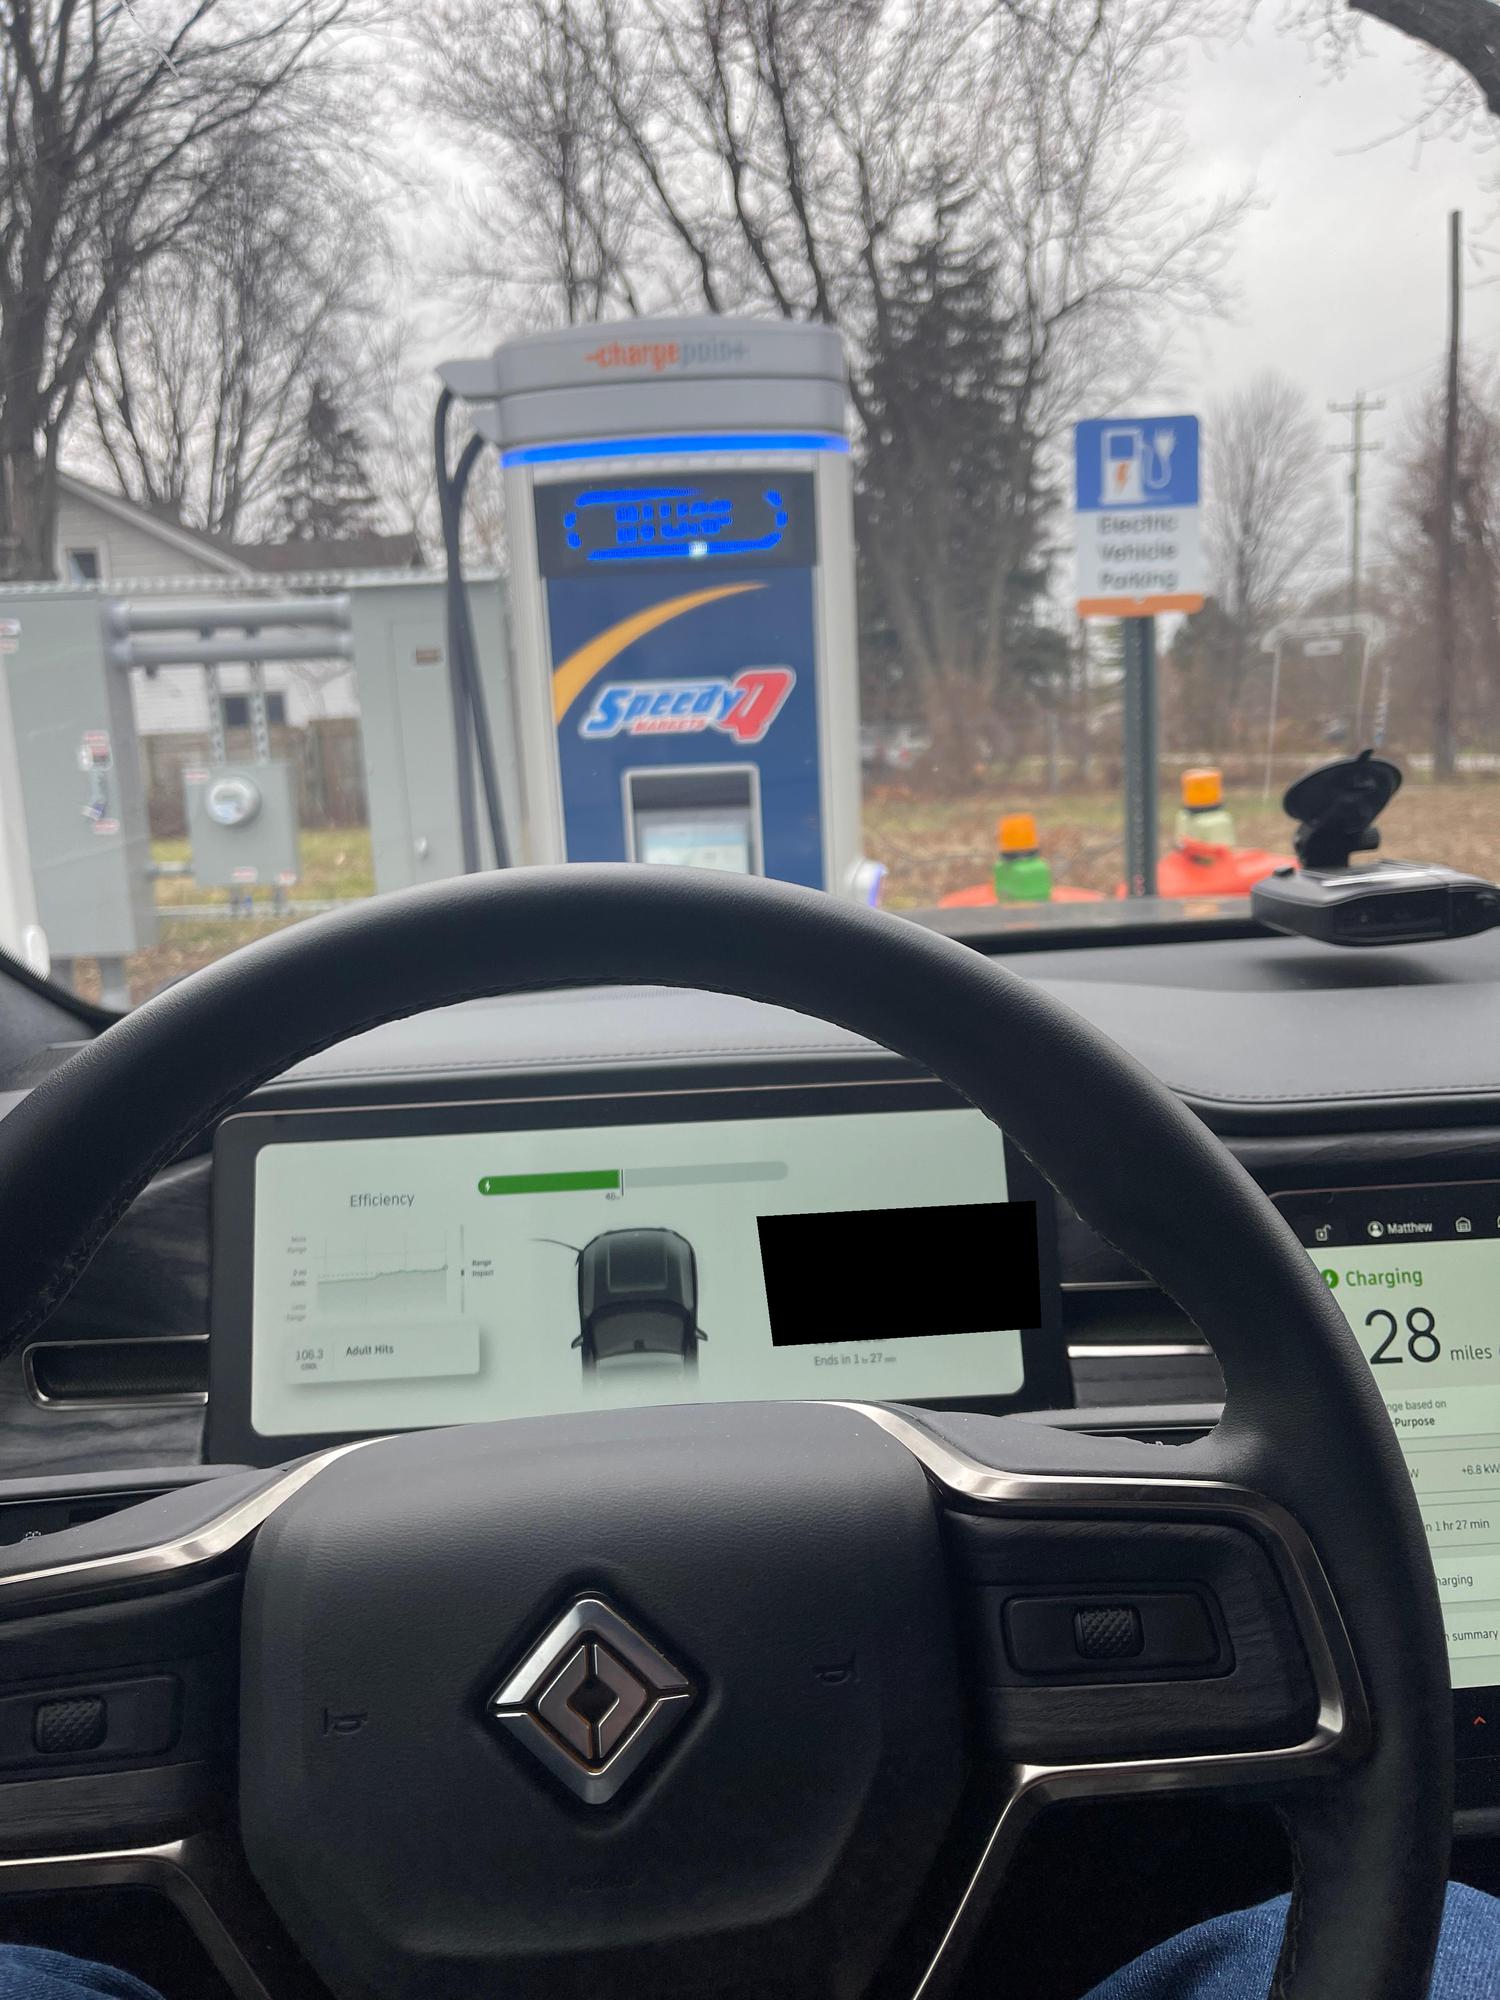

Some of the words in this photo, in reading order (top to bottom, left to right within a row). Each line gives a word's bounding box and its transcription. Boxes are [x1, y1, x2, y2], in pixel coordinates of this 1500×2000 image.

[1099, 516, 1178, 534] Electric
[1101, 544, 1177, 561] Vehicle
[1101, 572, 1178, 589] Parking
[350, 1192, 415, 1208] Efficiency
[1387, 1222, 1433, 1235] Matthew
[1346, 1268, 1423, 1289] Charging
[1365, 1307, 1441, 1365] 28
[1450, 1345, 1493, 1361] miles
[346, 1346, 372, 1356] Adult
[375, 1345, 394, 1355] Hits
[814, 1354, 839, 1366] Ends
[842, 1354, 851, 1365] in
[854, 1354, 860, 1364] 1
[870, 1353, 883, 1363] 27
[1386, 1402, 1403, 1413] nge
[1405, 1400, 1433, 1410] based
[1435, 1400, 1447, 1409] on
[1436, 1521, 1441, 1531] 1
[1443, 1520, 1454, 1531] hr
[1456, 1519, 1468, 1530] 27
[1469, 1518, 1490, 1529] min
[1452, 1629, 1498, 1641] summary
